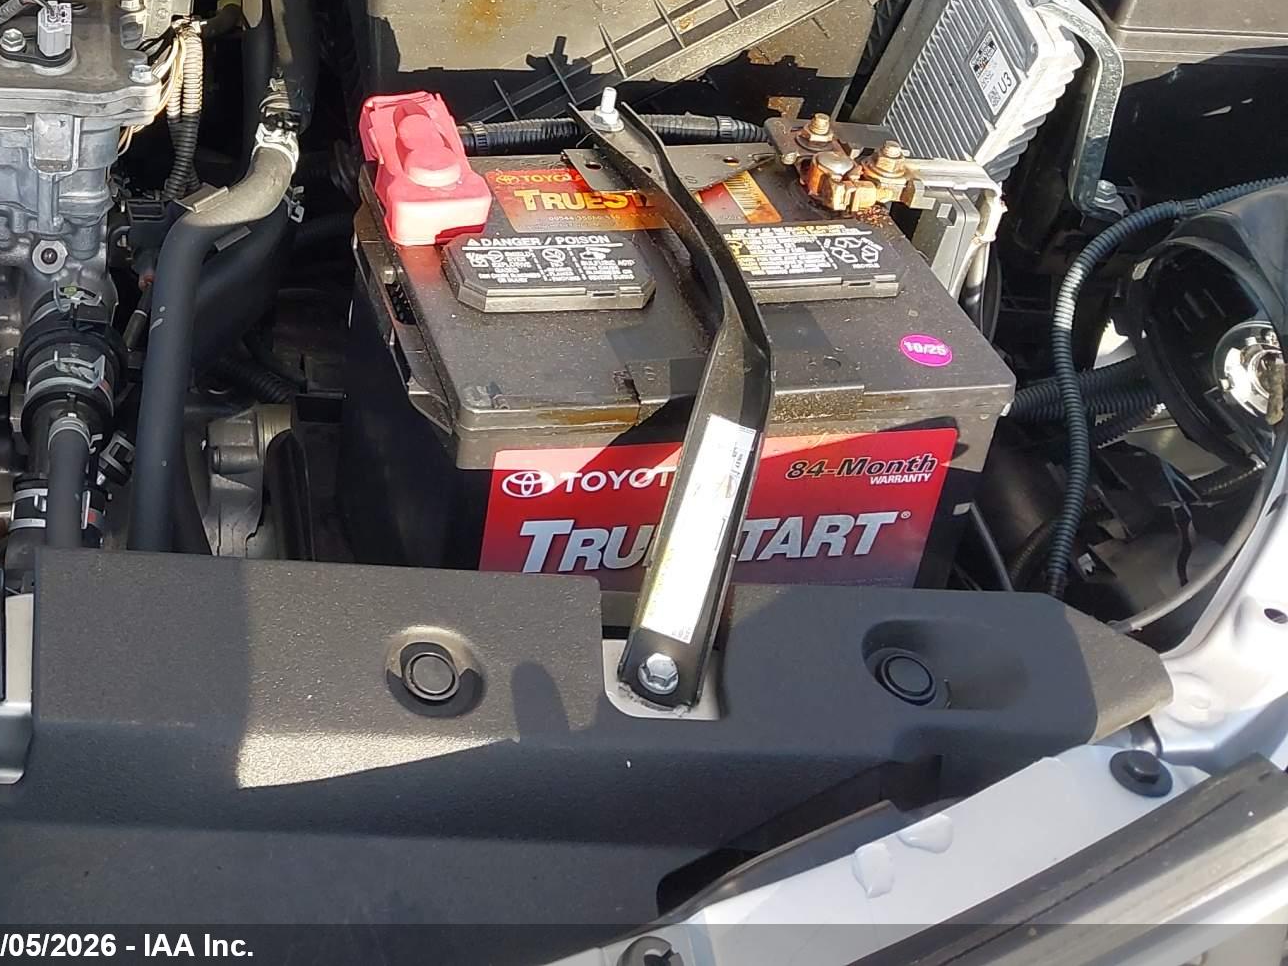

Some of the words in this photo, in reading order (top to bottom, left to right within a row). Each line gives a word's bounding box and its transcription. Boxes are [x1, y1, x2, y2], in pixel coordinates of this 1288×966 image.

[997, 71, 1013, 95] U3
[481, 237, 541, 246] DANGER
[555, 235, 611, 245] POISON
[785, 453, 937, 479] 84-Month
[560, 466, 677, 493] TOYOT
[870, 473, 932, 485] WARRANTY
[520, 512, 899, 574] TRUTART
